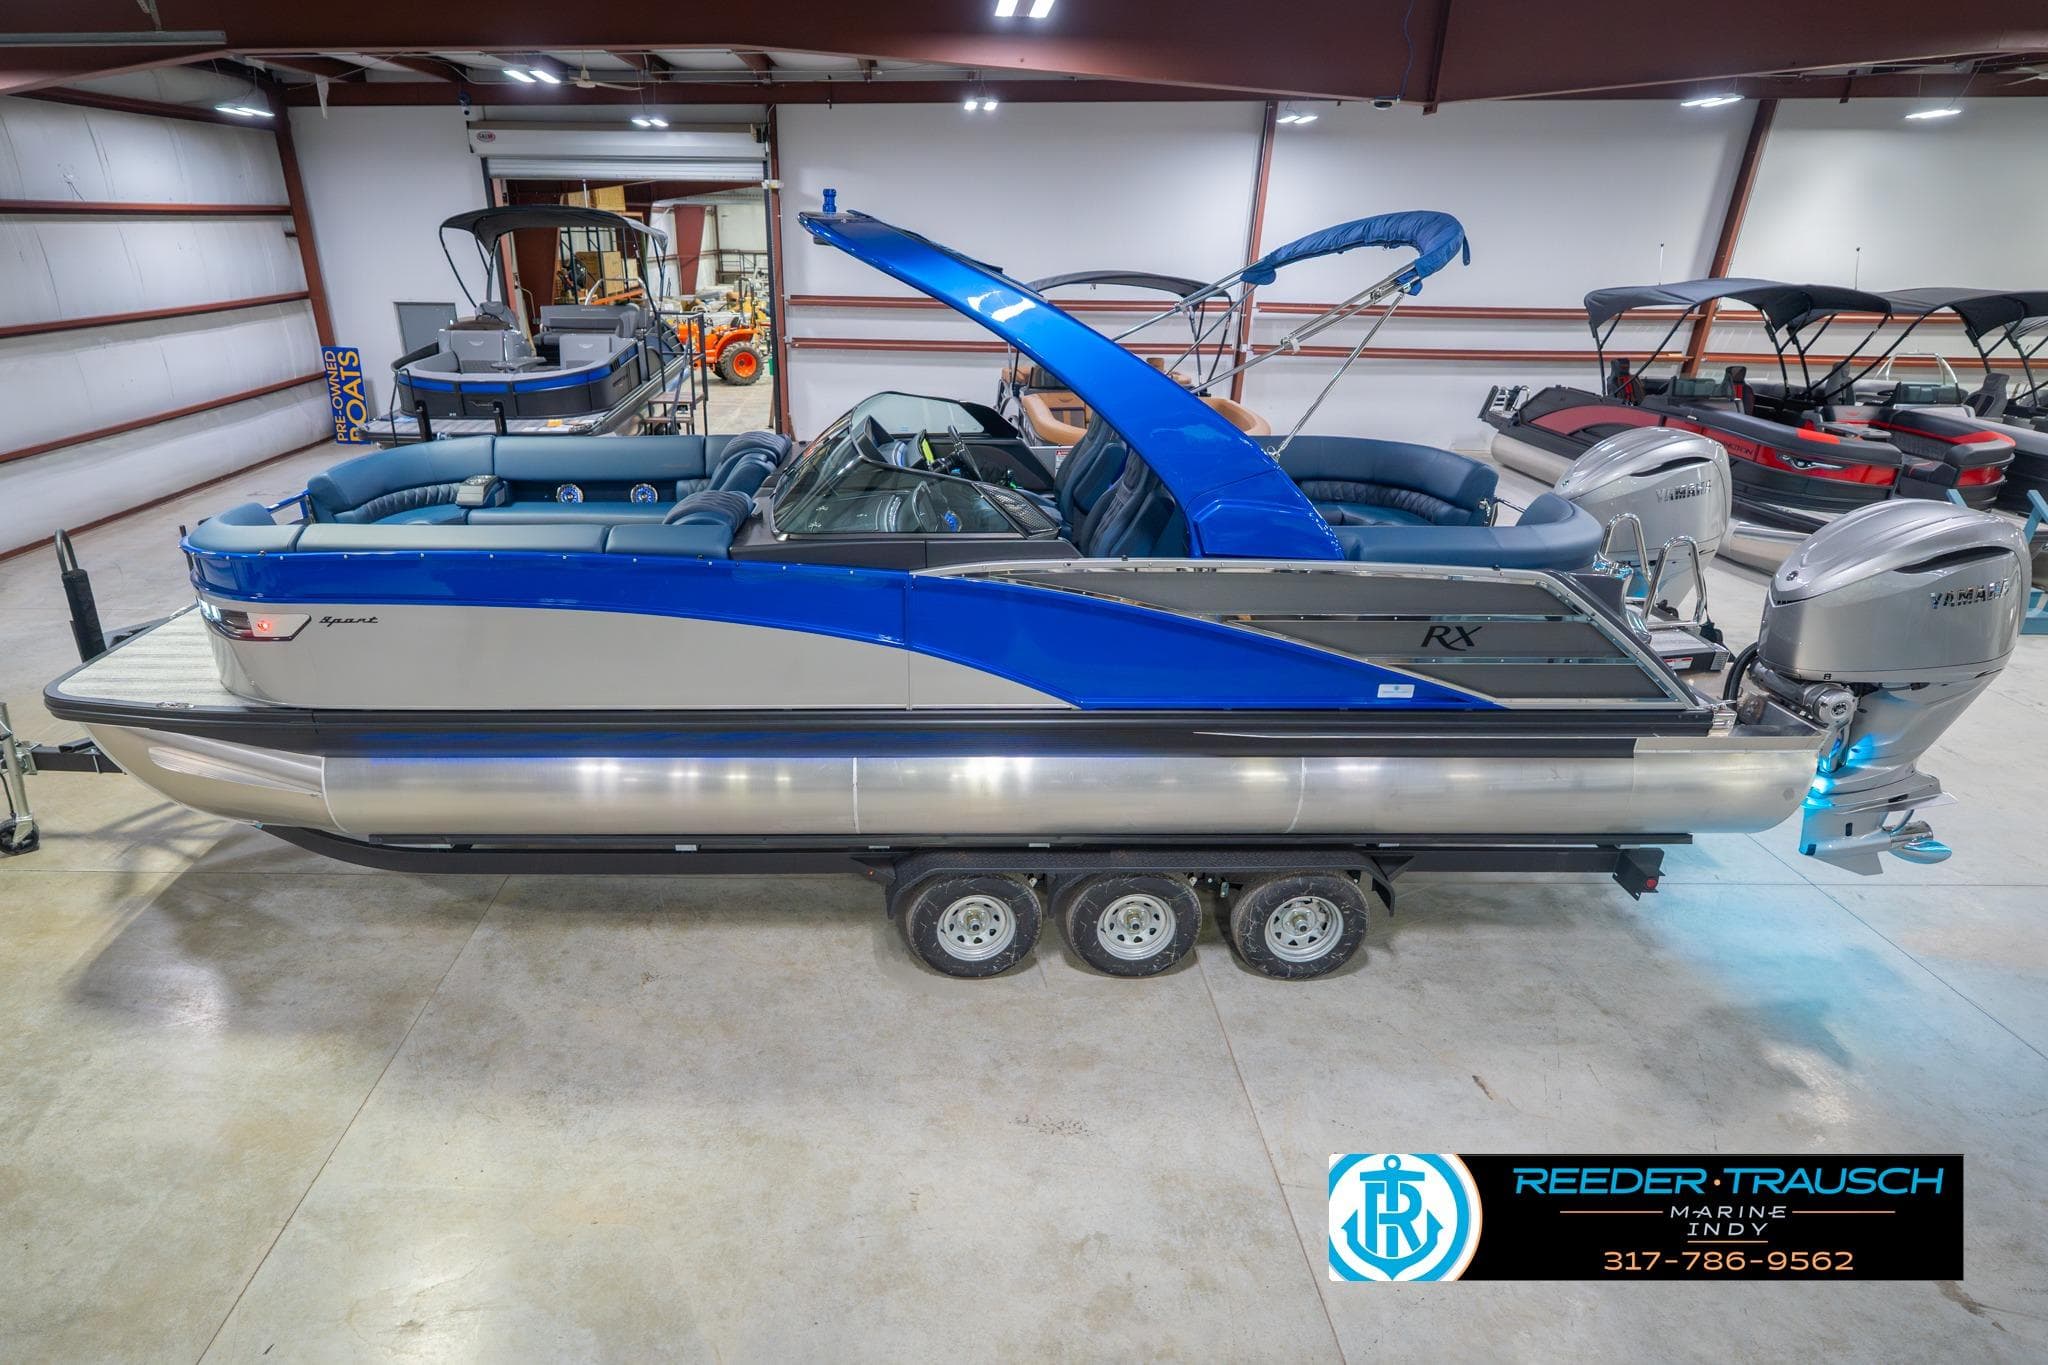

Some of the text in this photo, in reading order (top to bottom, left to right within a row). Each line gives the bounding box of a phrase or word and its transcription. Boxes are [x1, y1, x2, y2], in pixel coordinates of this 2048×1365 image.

[325, 350, 348, 442] PRE-OWNED
[319, 615, 378, 628] Sport
[1421, 625, 1482, 652] RX
